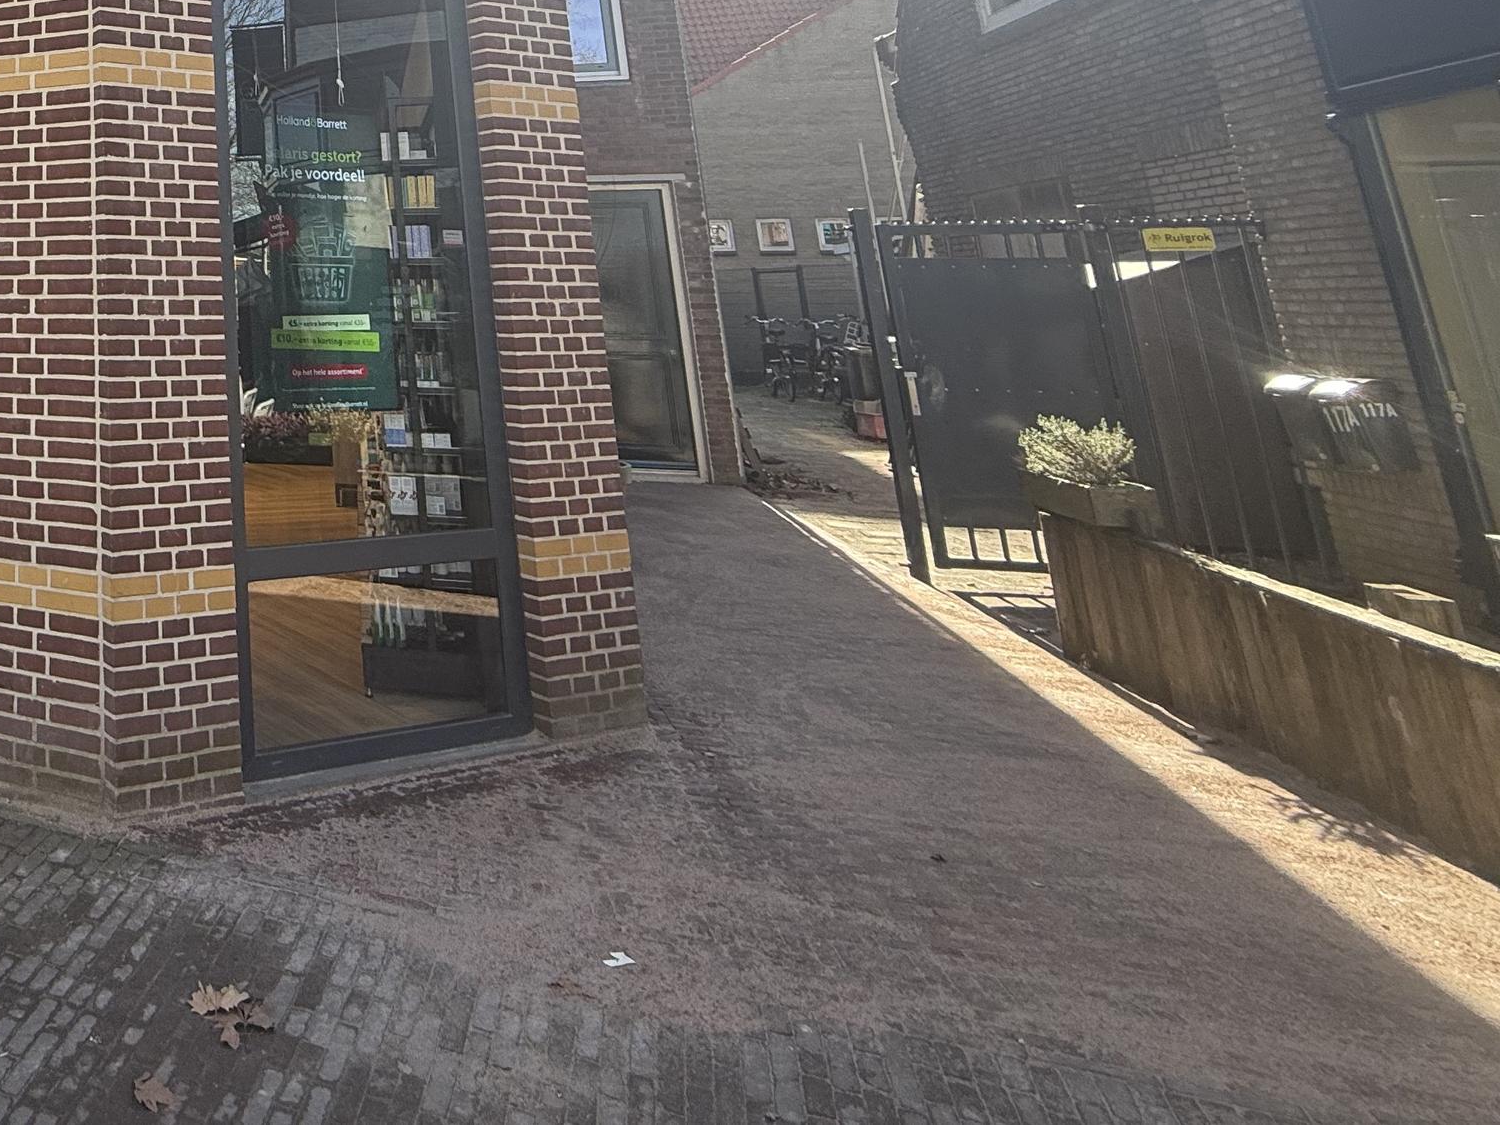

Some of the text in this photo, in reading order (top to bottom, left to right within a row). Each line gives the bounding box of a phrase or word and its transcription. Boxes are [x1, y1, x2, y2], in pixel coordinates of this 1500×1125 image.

[311, 150, 362, 164] gestort?
[264, 164, 366, 182] Pak je voordeel!
[1164, 233, 1212, 244] Ruigrok
[292, 369, 302, 378] Op
[302, 368, 313, 376] het
[313, 368, 326, 376] hele
[1359, 402, 1398, 418] 117A
[1322, 405, 1360, 434] 117A
